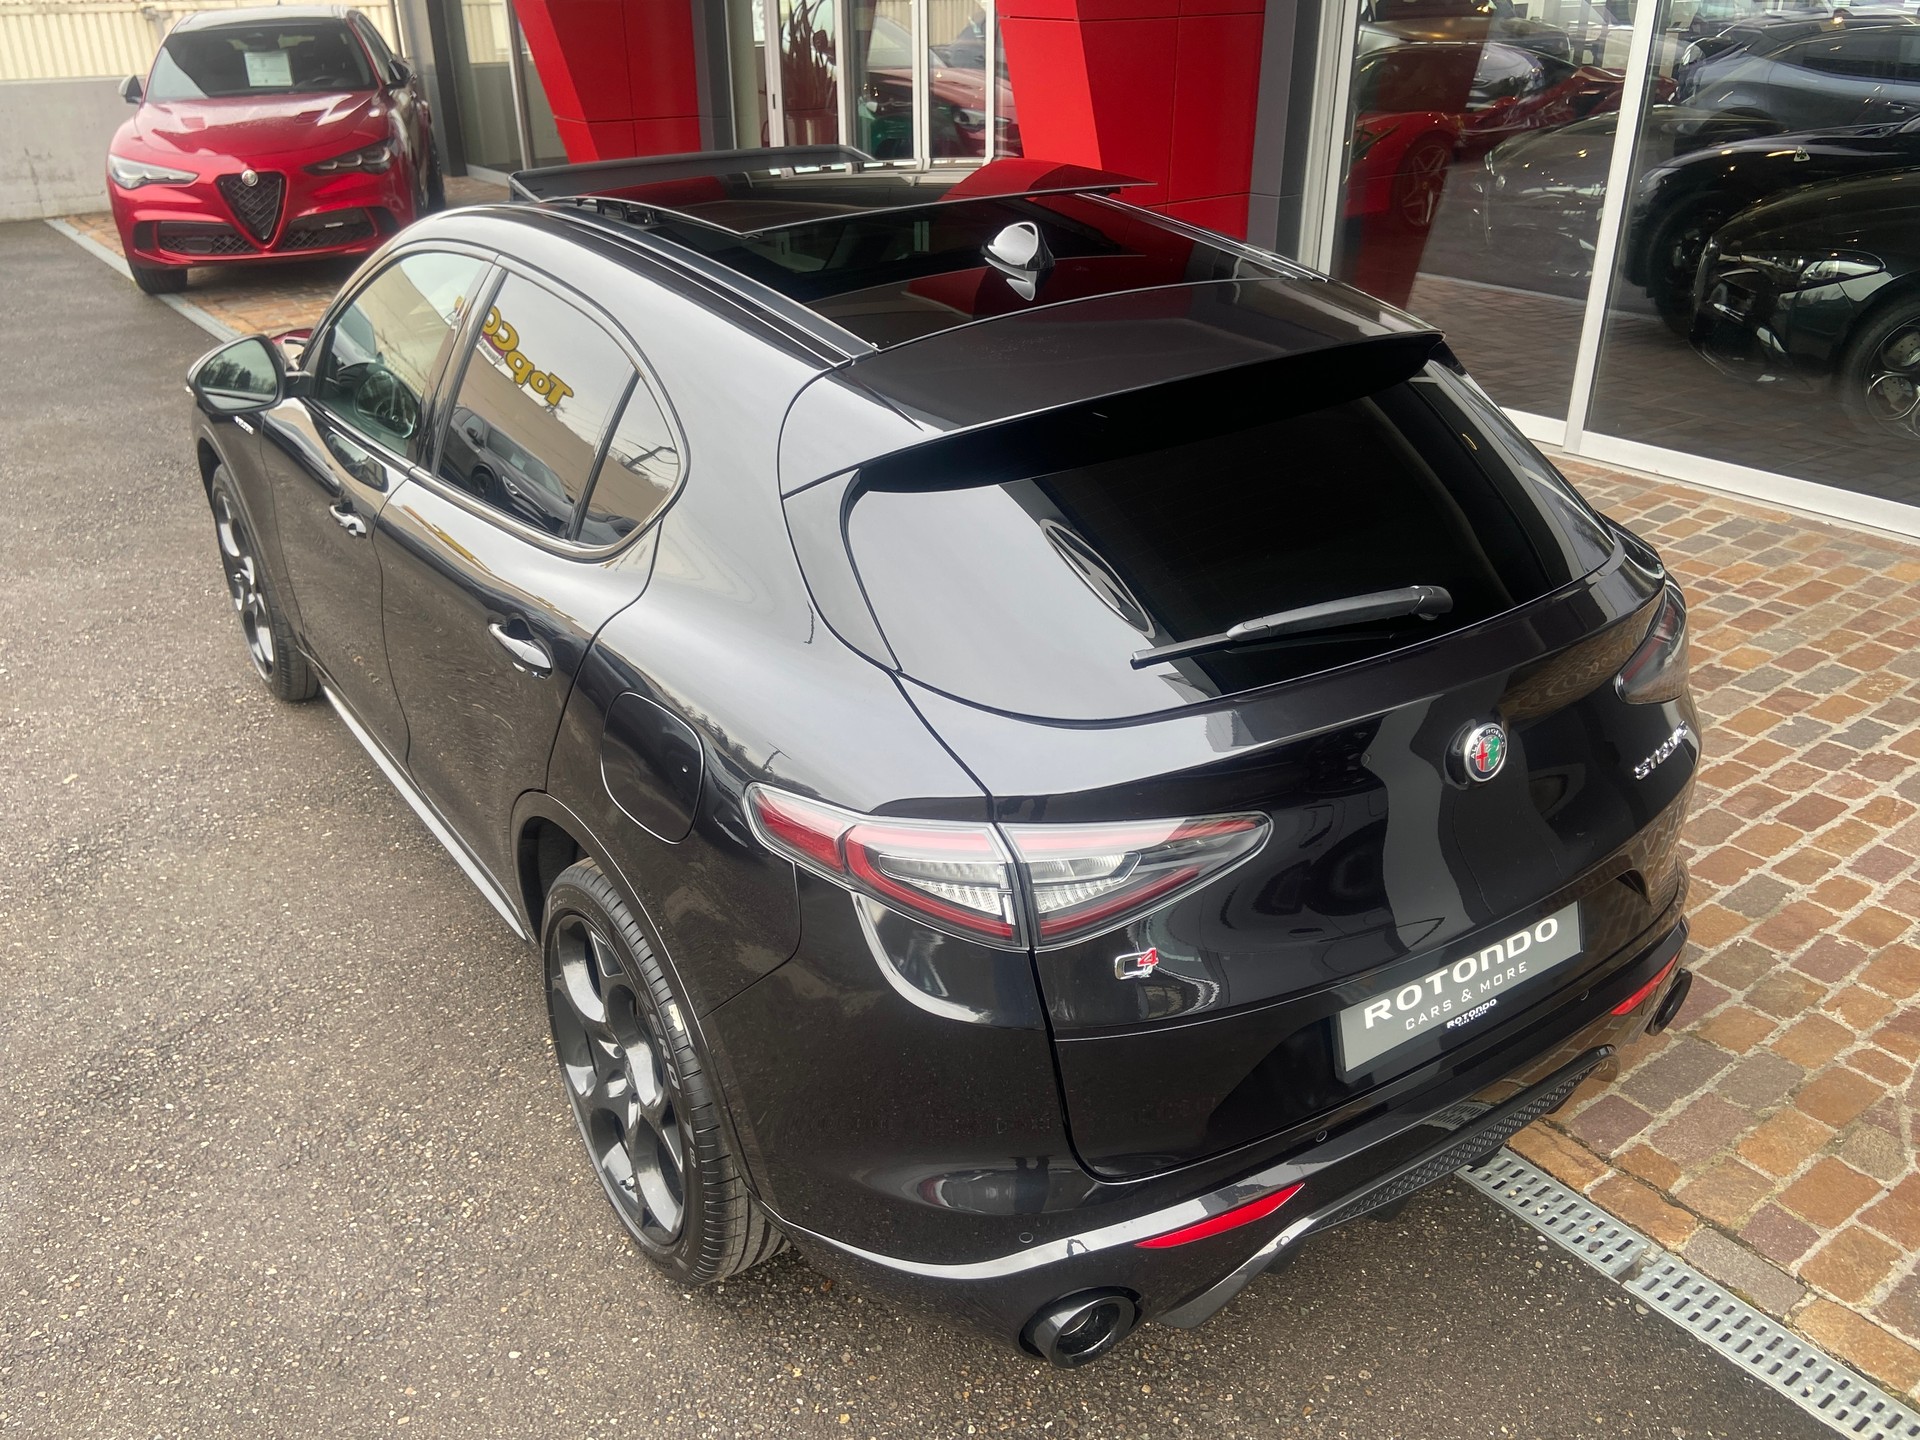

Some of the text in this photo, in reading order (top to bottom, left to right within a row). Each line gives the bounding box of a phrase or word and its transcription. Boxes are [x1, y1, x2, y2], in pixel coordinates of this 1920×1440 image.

[1364, 917, 1558, 1029] ROTONDO
[1405, 1000, 1452, 1030] CARS
[1461, 988, 1473, 1002] &
[1480, 961, 1527, 993] MORE
[1446, 998, 1497, 1029] ROTONDO
